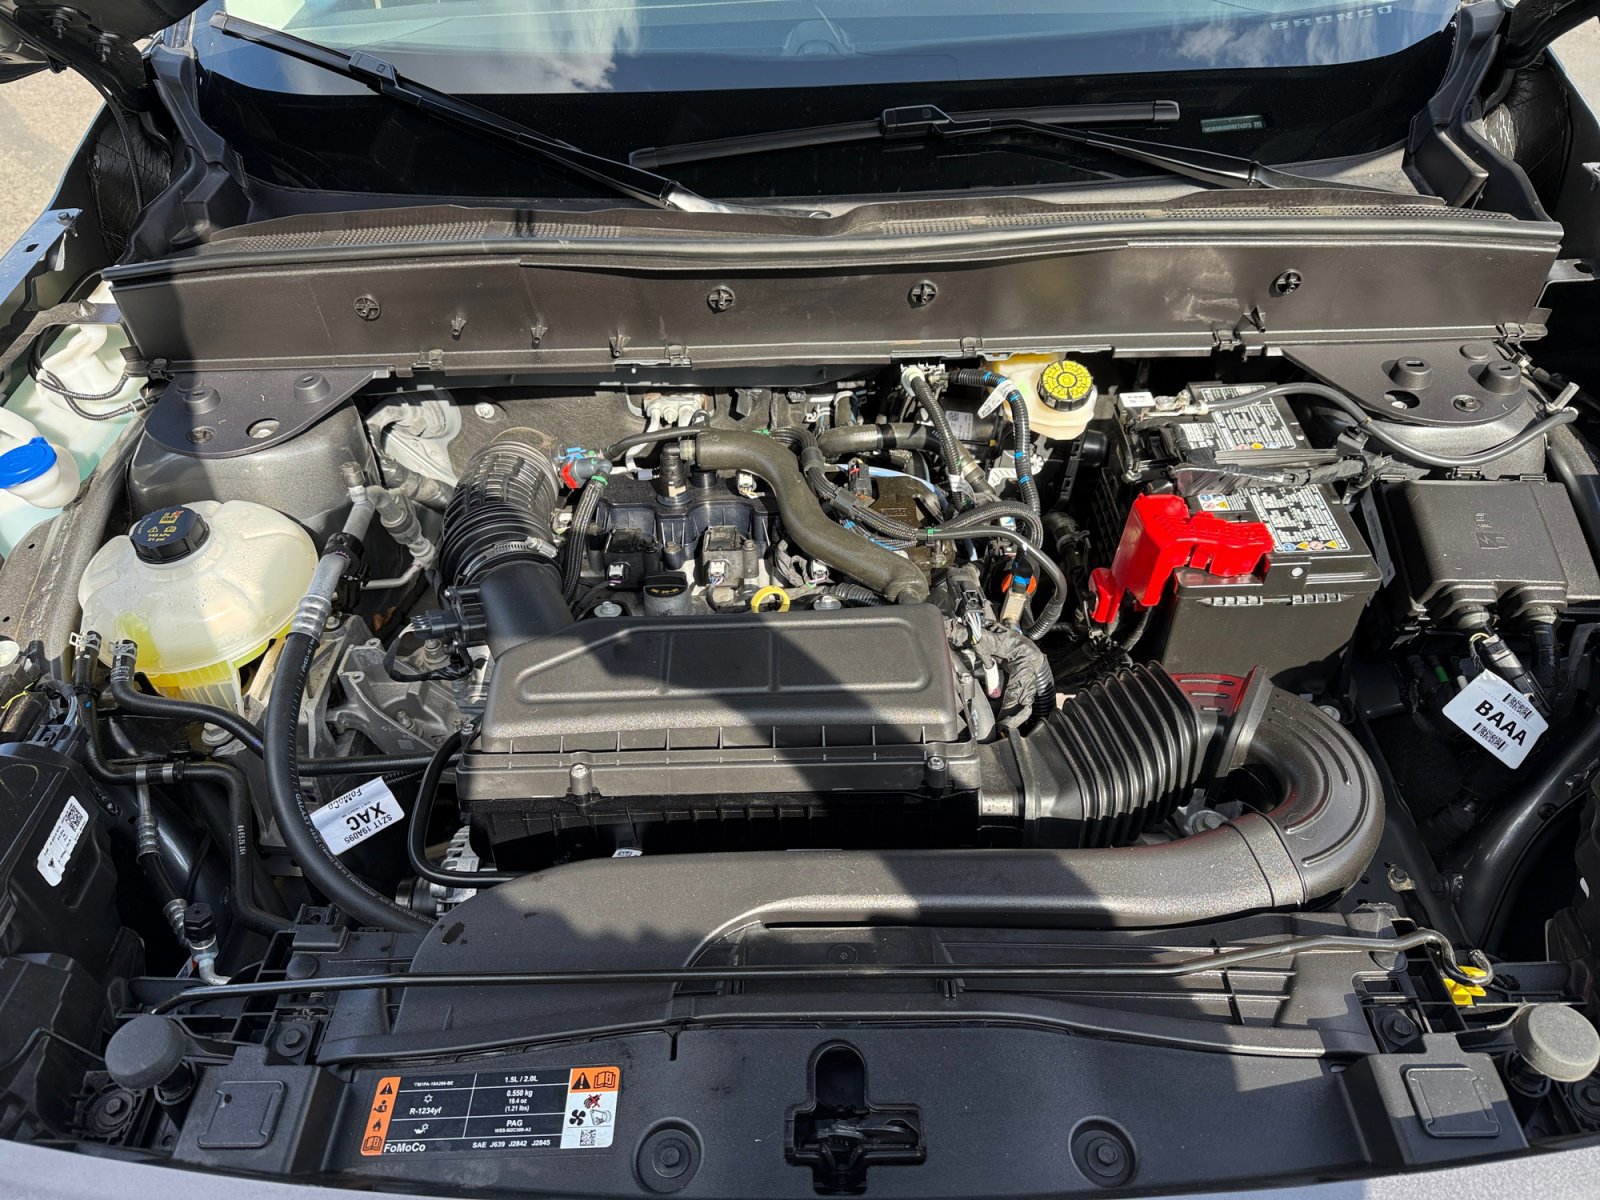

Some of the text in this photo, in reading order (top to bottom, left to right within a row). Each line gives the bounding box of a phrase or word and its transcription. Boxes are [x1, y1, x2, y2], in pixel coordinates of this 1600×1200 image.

[1270, 5, 1393, 30] BRONCO
[1475, 700, 1527, 747] BAAA
[327, 787, 362, 810] FoMoCo
[346, 801, 386, 831] XAC
[344, 813, 393, 844] SZ1T 19A095
[523, 1075, 539, 1083] 2.0L
[524, 1089, 533, 1098] kg
[409, 1106, 442, 1116] R-1234yf
[504, 1105, 518, 1113] (1.21
[506, 1119, 523, 1127] PAG
[383, 1142, 426, 1154] FoMoCo
[472, 1139, 551, 1149] SAE J639 J2842 J2845
